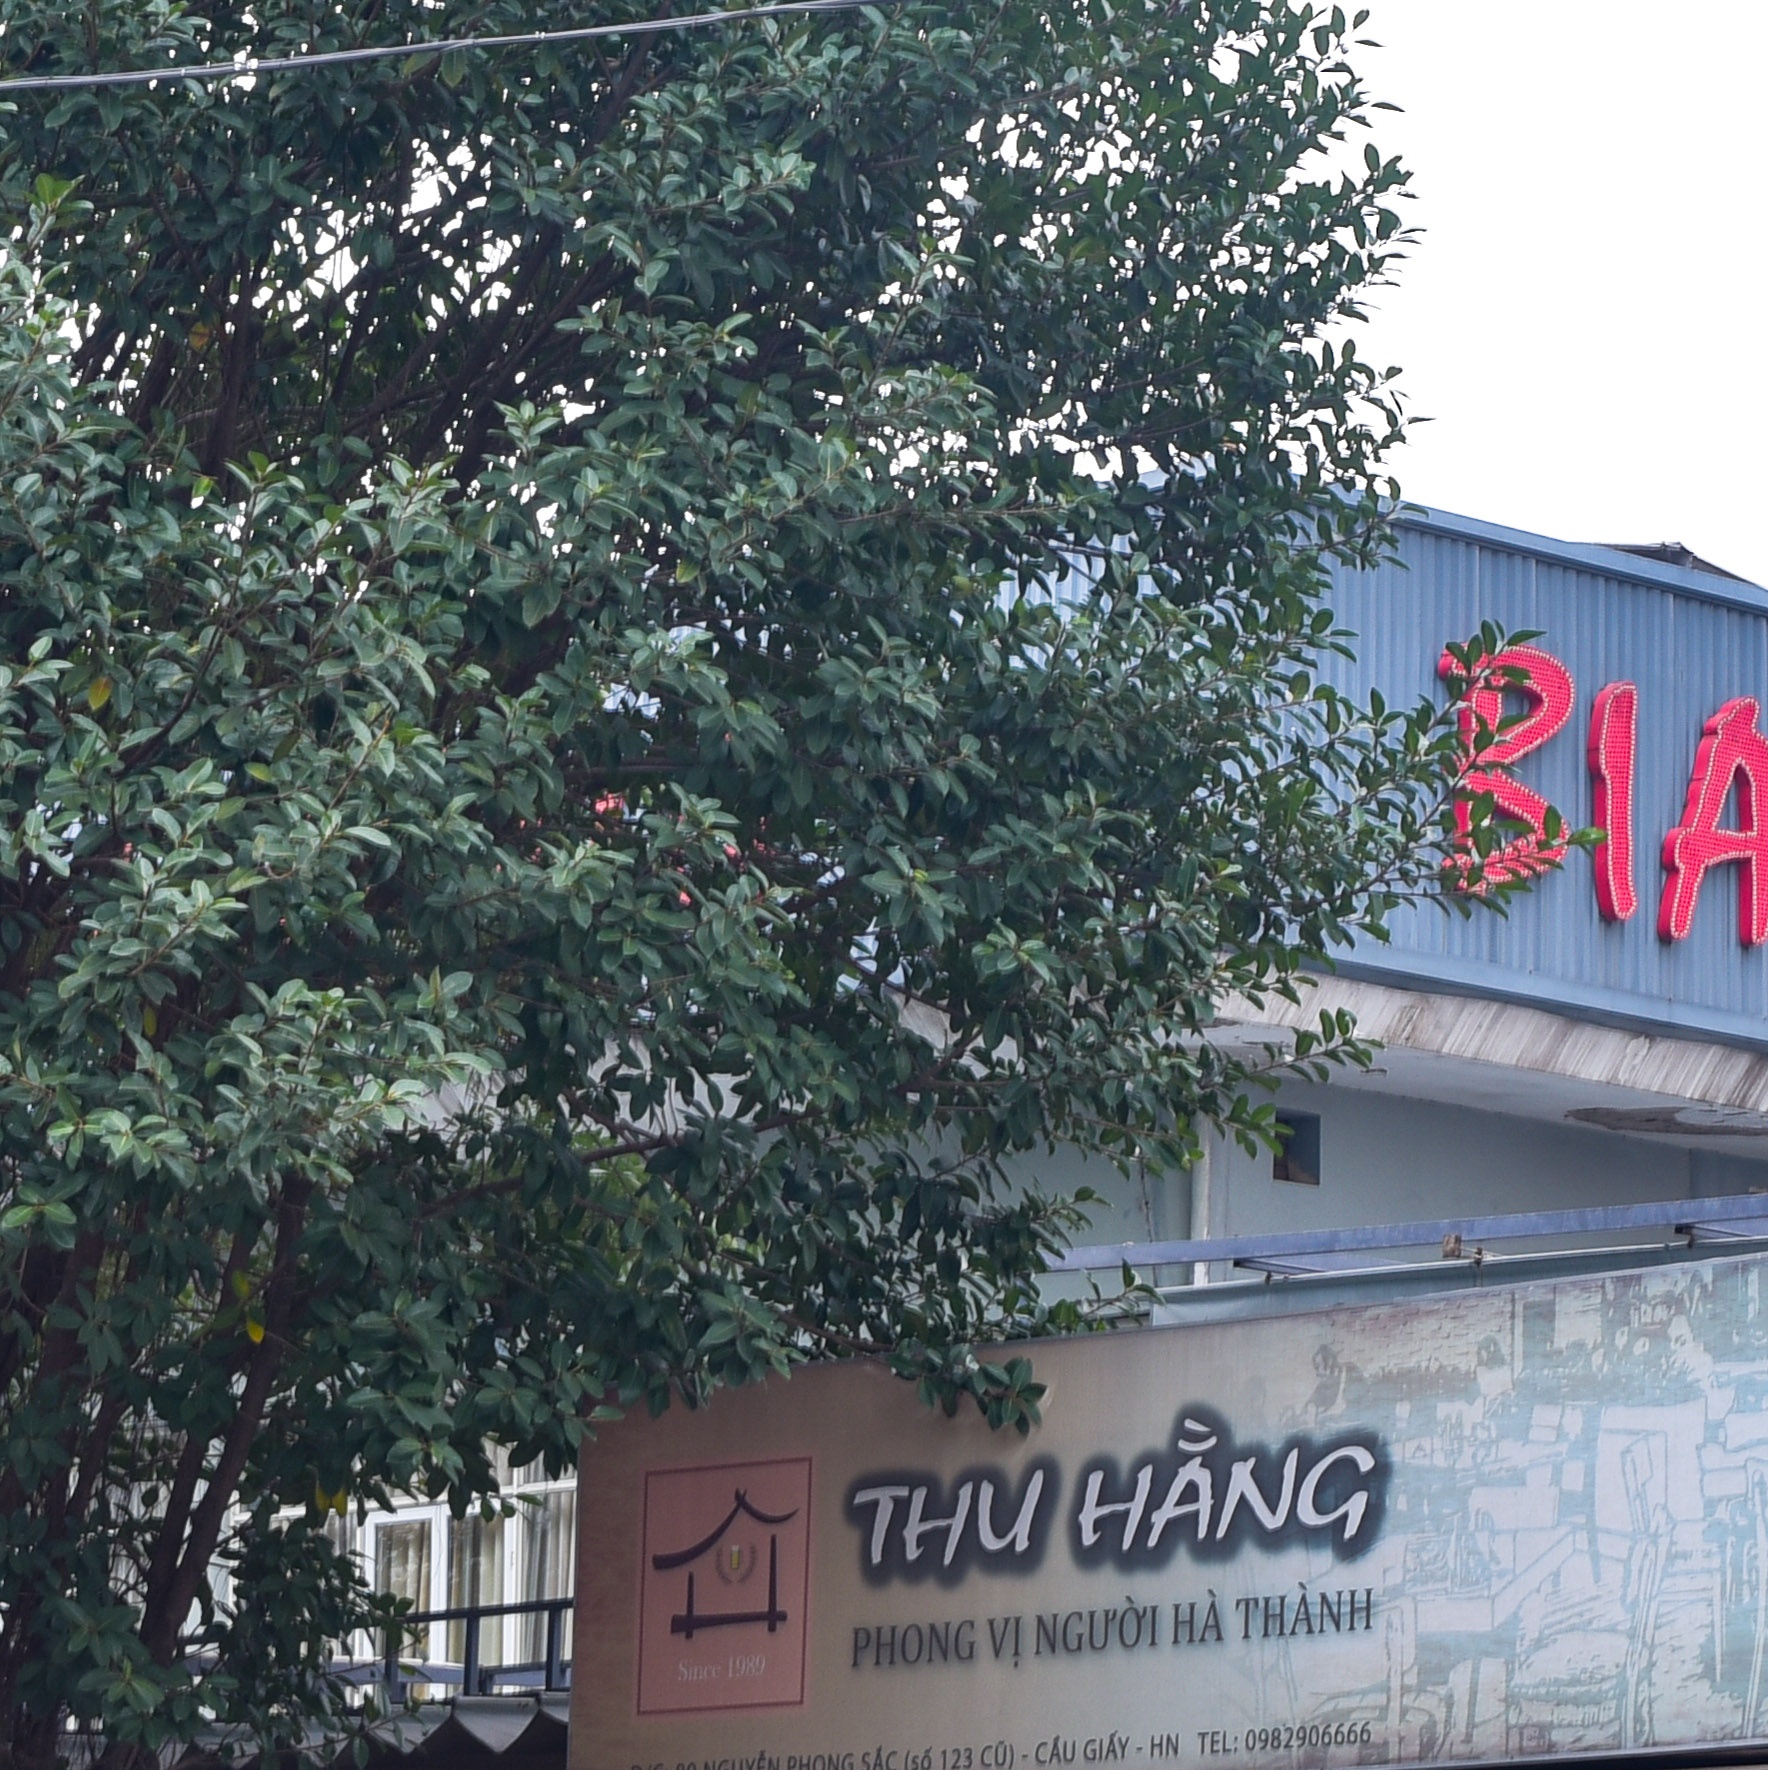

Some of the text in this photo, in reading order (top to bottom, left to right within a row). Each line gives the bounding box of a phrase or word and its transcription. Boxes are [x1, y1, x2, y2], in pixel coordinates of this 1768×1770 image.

[853, 1418, 1375, 1567] THU HẰNG
[850, 1581, 1374, 1669] PHONG VỊ NGƯỜI HÀ THÀNH
[678, 1655, 766, 1682] Since 1989
[941, 1747, 973, 1770] 123
[980, 1740, 1015, 1770] CŨ)
[1035, 1735, 1076, 1765] CẦU
[1083, 1730, 1130, 1762] GIẤY
[1150, 1733, 1180, 1759] HN
[1197, 1730, 1238, 1755] TEL:
[1245, 1721, 1372, 1751] 0982906666
